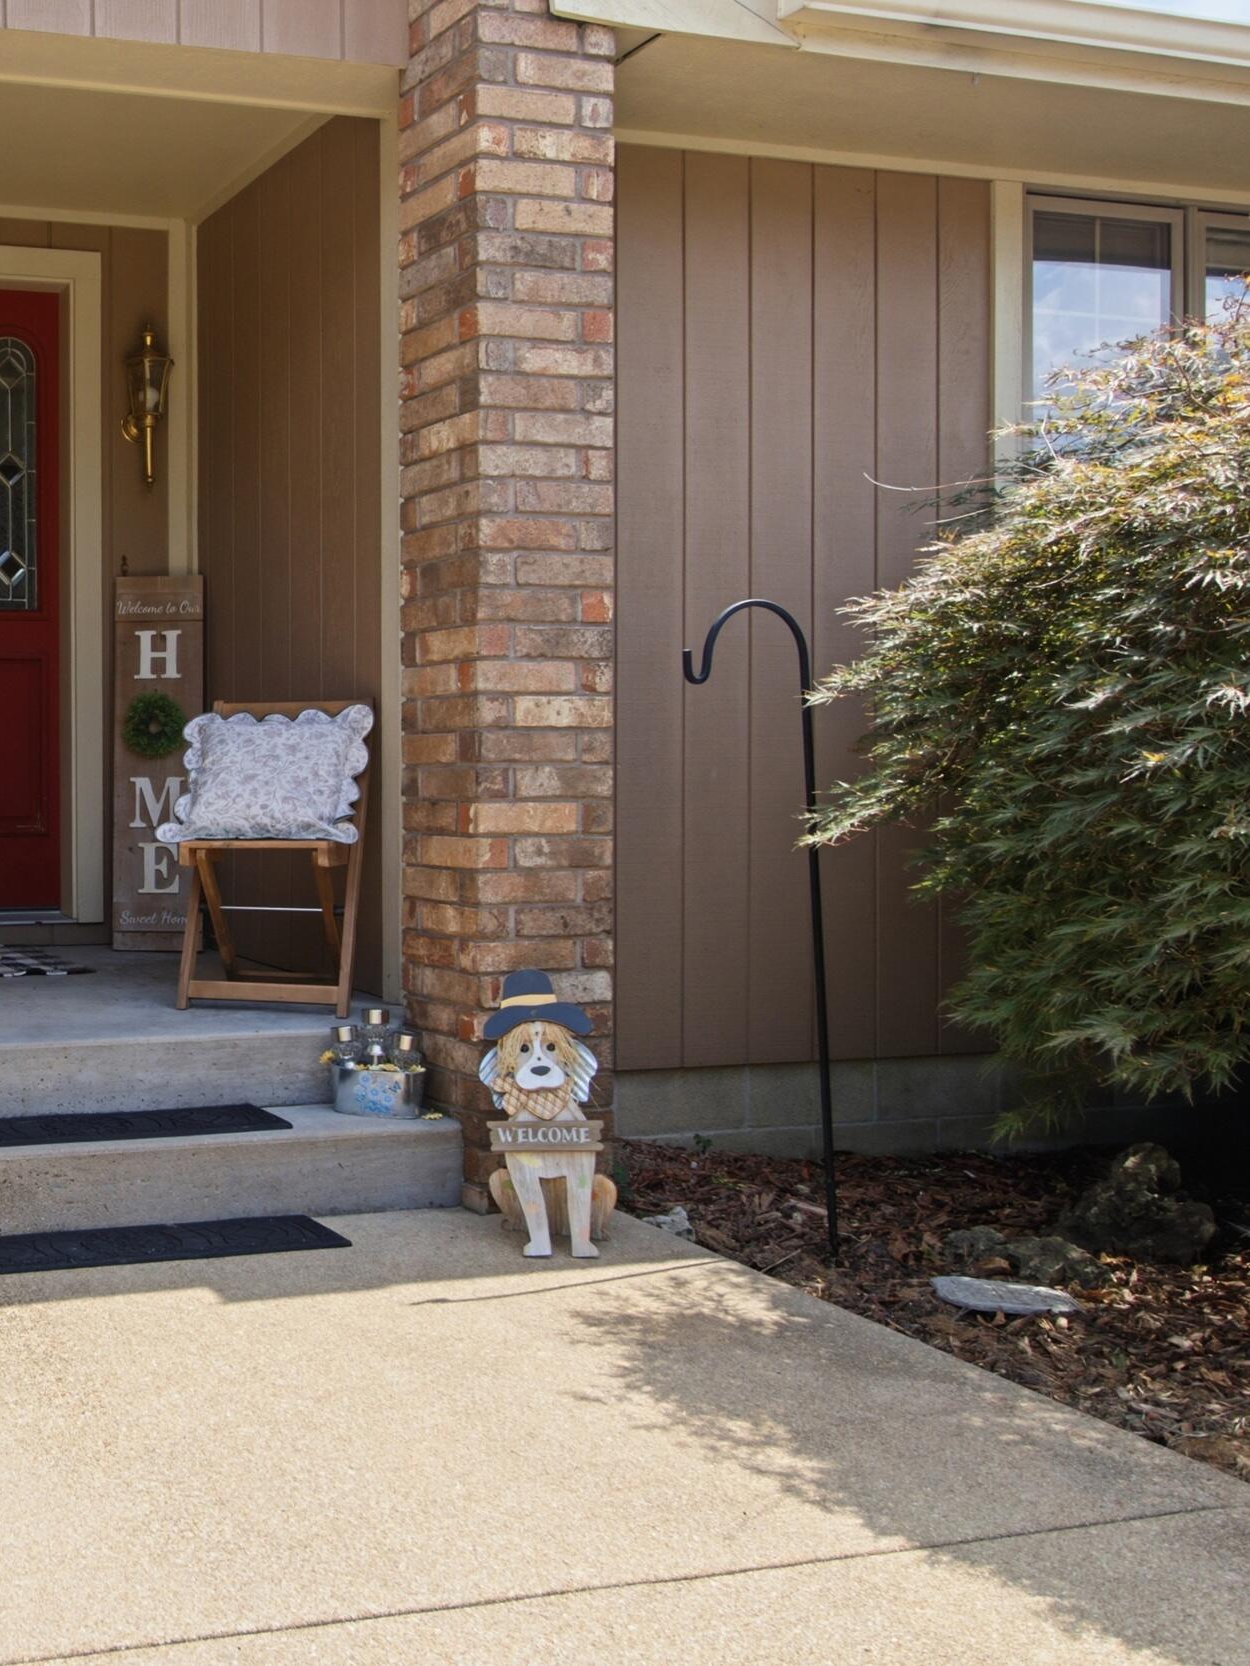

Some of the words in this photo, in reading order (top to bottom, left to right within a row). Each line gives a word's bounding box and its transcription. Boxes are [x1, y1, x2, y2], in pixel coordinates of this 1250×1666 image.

[116, 600, 163, 614] Welcome
[165, 602, 177, 614] to
[179, 600, 201, 614] Our
[119, 911, 157, 925] Sweet
[161, 911, 188, 925] Hom
[498, 1127, 591, 1144] WELCOME
